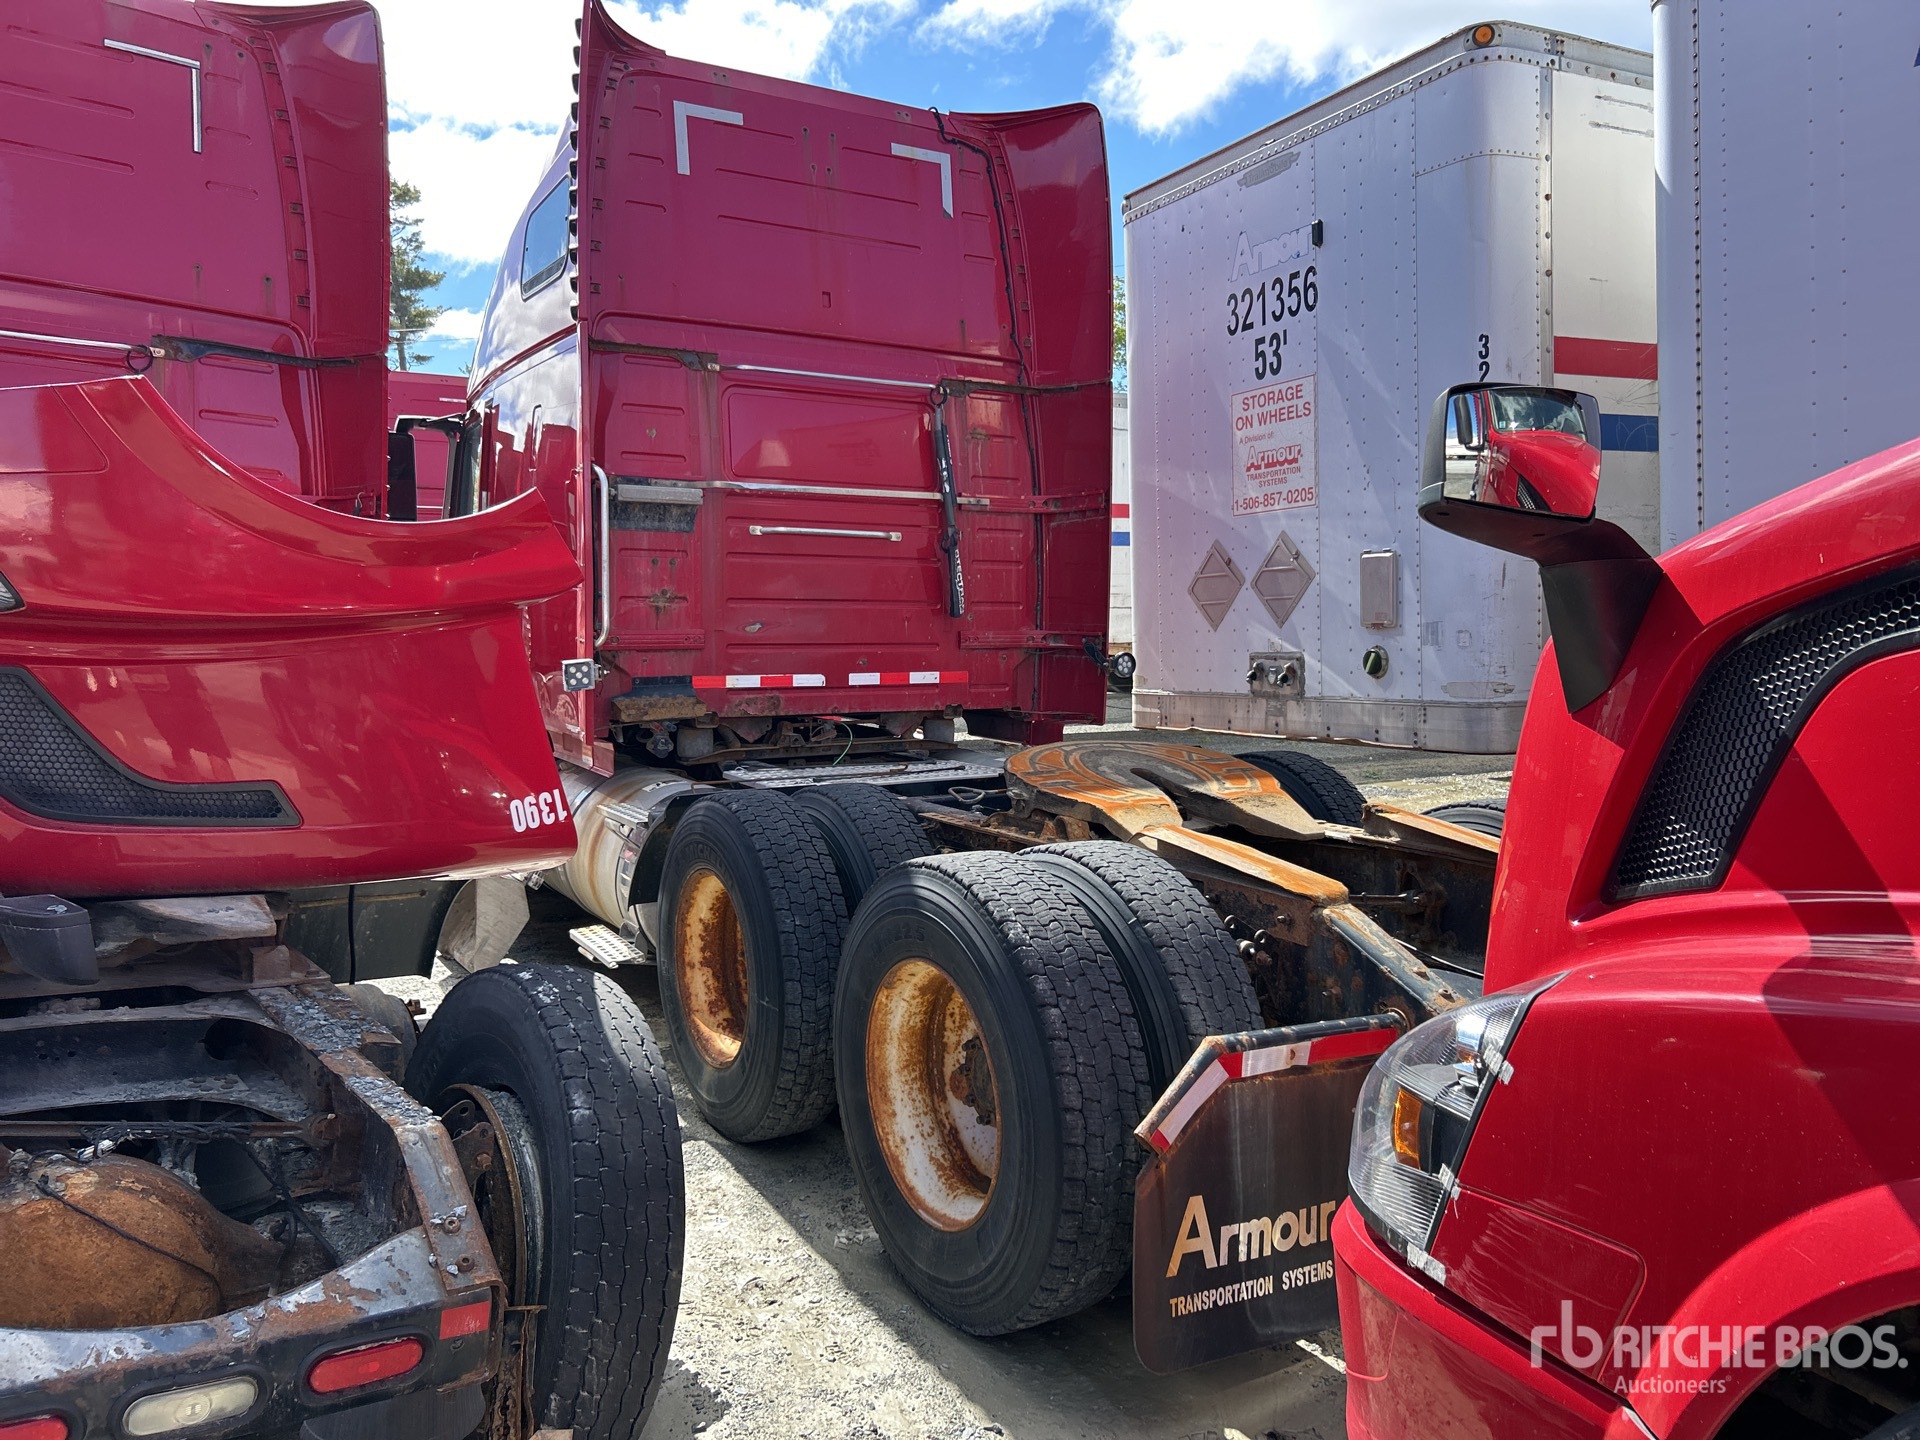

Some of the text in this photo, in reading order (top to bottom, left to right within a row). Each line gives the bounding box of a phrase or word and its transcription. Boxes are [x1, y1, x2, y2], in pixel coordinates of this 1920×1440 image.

[1226, 265, 1319, 336] 321356
[1254, 329, 1288, 380] 53'
[1242, 384, 1303, 411] STORAGE
[1235, 401, 1312, 431] ON WHEELS
[1244, 432, 1266, 444] Division
[1245, 444, 1302, 472] Armour
[1246, 466, 1301, 482] TRANSPORTATION
[1258, 476, 1288, 488] SYSTEMS
[1234, 487, 1314, 512] 1-506-857-0205
[509, 788, 568, 833] 1390
[1165, 1194, 1336, 1278] Armour
[1169, 1259, 1334, 1318] TRANSPORTATION SYSTEMS
